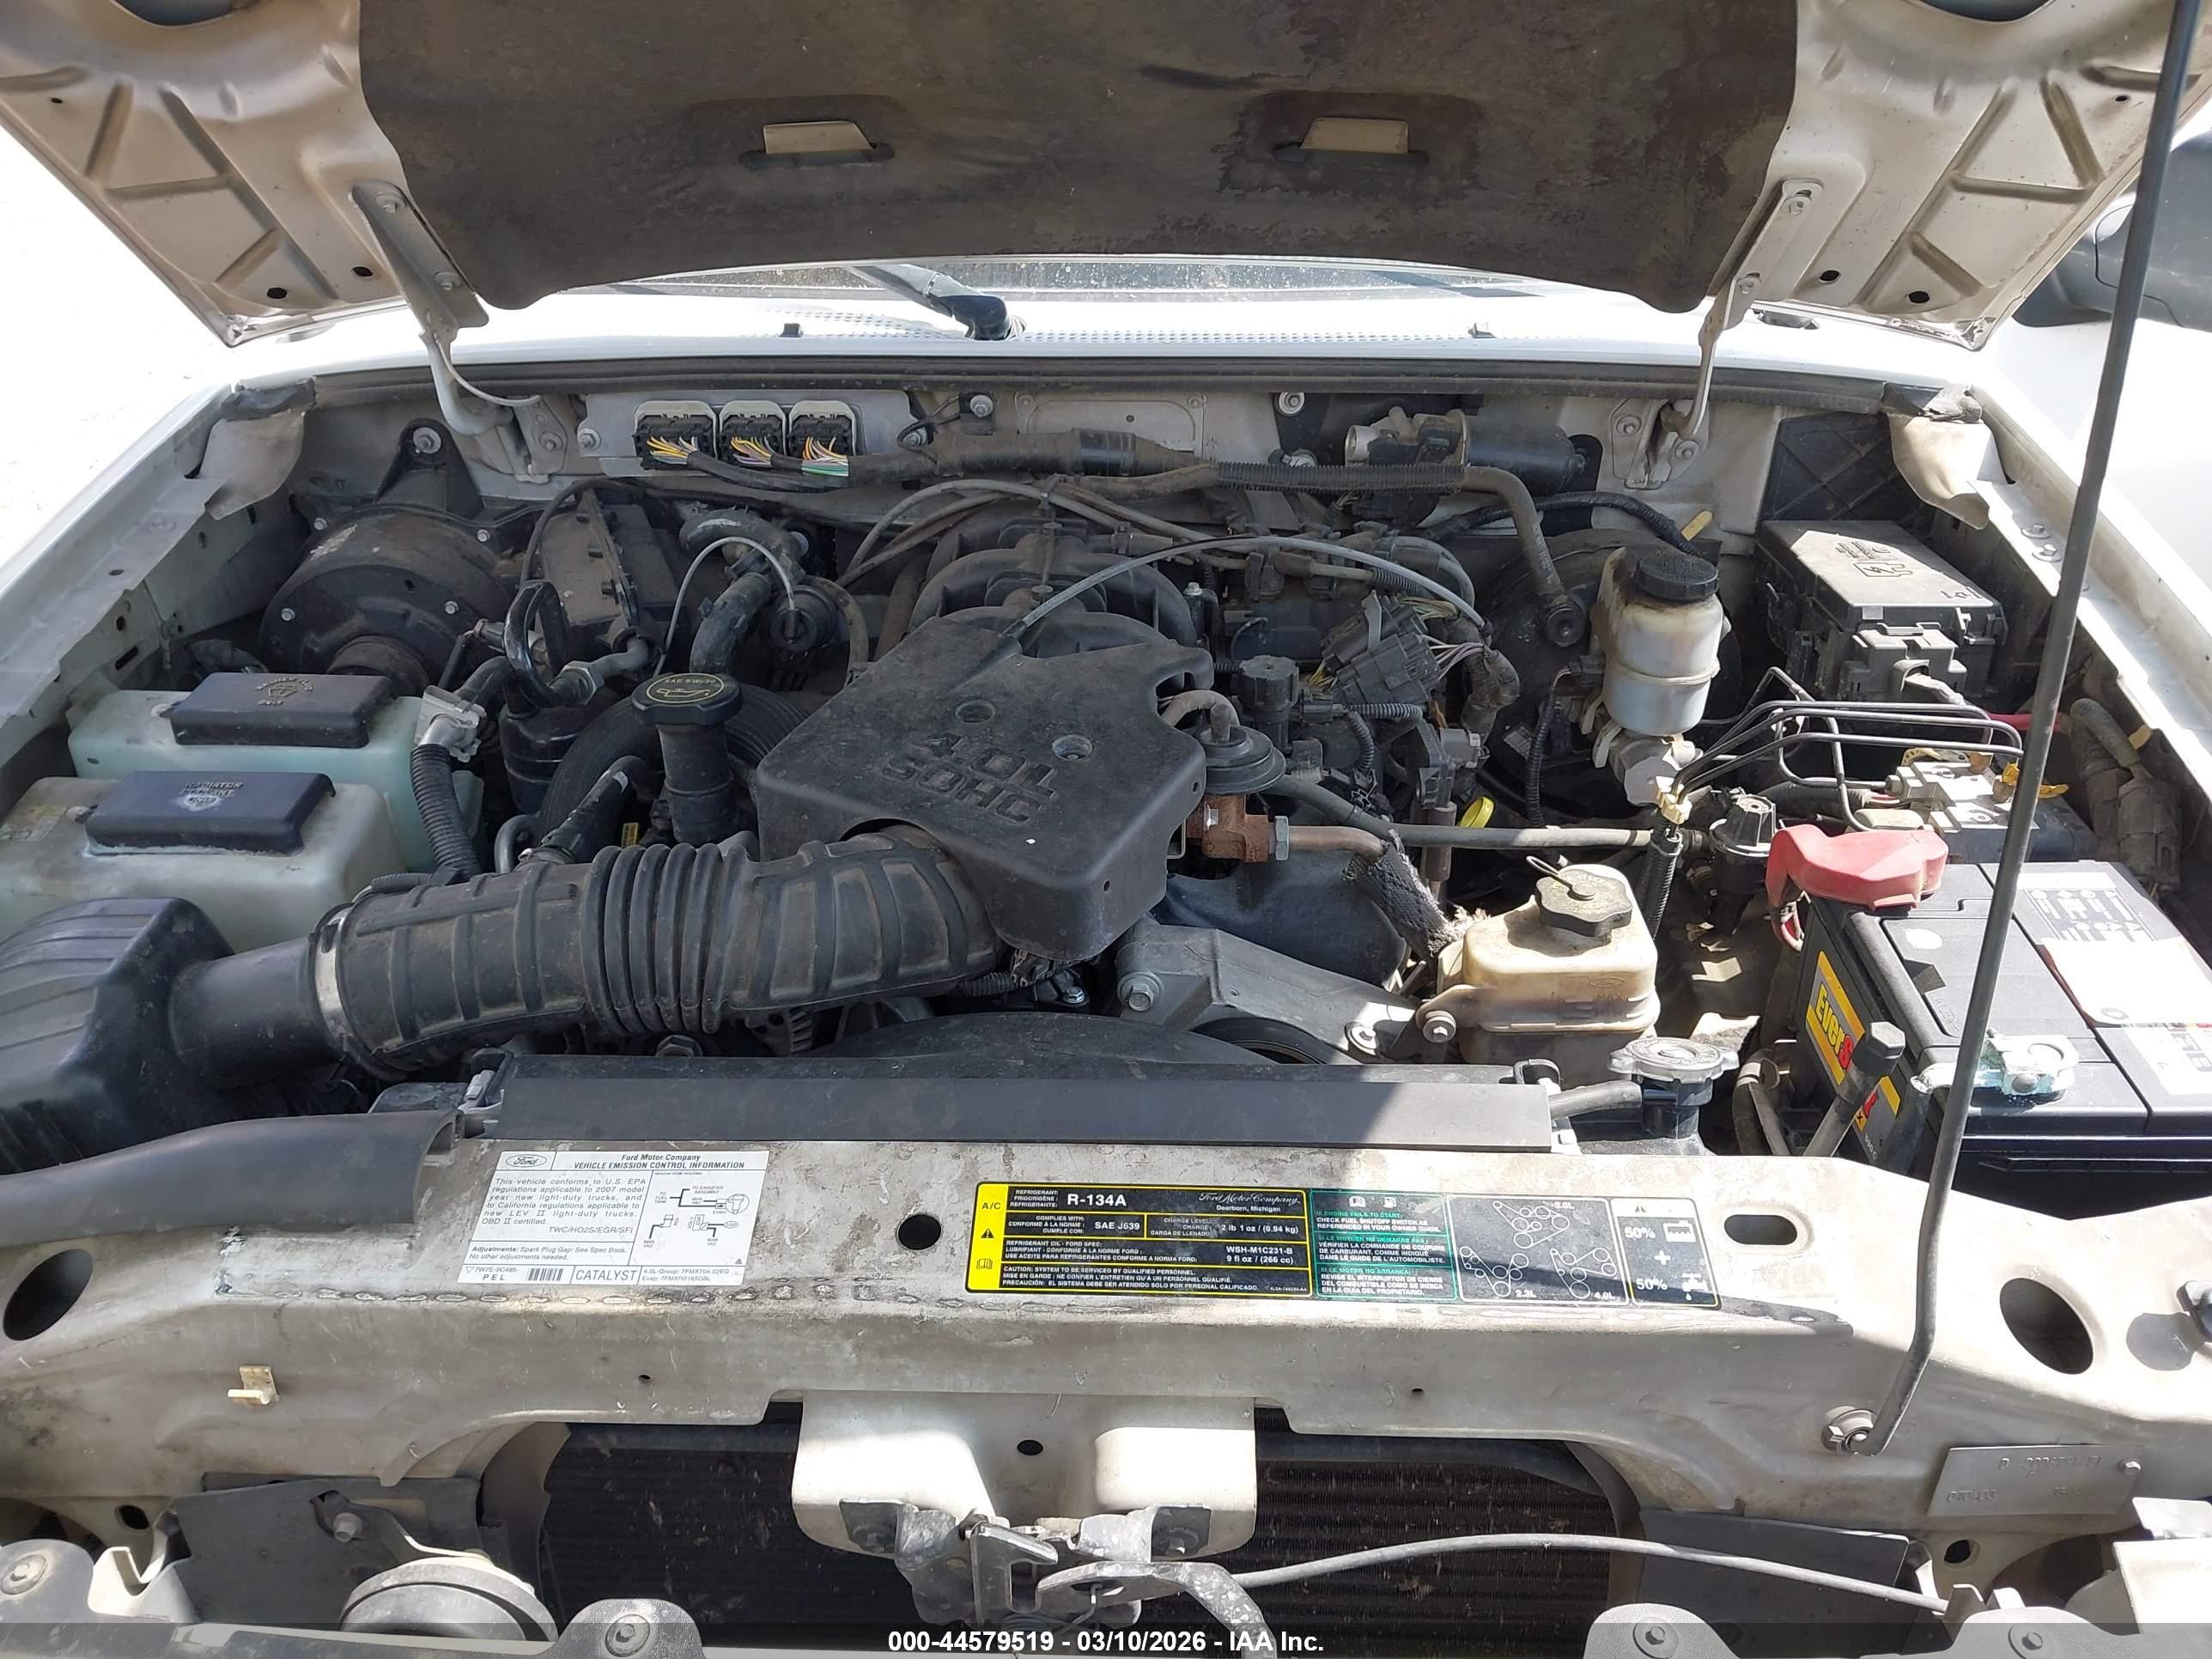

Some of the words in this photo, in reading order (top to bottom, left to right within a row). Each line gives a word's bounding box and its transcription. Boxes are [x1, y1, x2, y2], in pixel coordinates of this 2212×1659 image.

[880, 756, 1042, 823] SOHC
[514, 1155, 539, 1166] Ford
[1067, 1194, 1126, 1206] R-134A
[1199, 1192, 1222, 1200] Ford
[1224, 1193, 1250, 1204] Motor
[1251, 1194, 1300, 1206] Company
[1625, 1226, 1656, 1238] 50%
[575, 1270, 637, 1280] CATALYST
[1636, 1279, 1668, 1290] 50%
